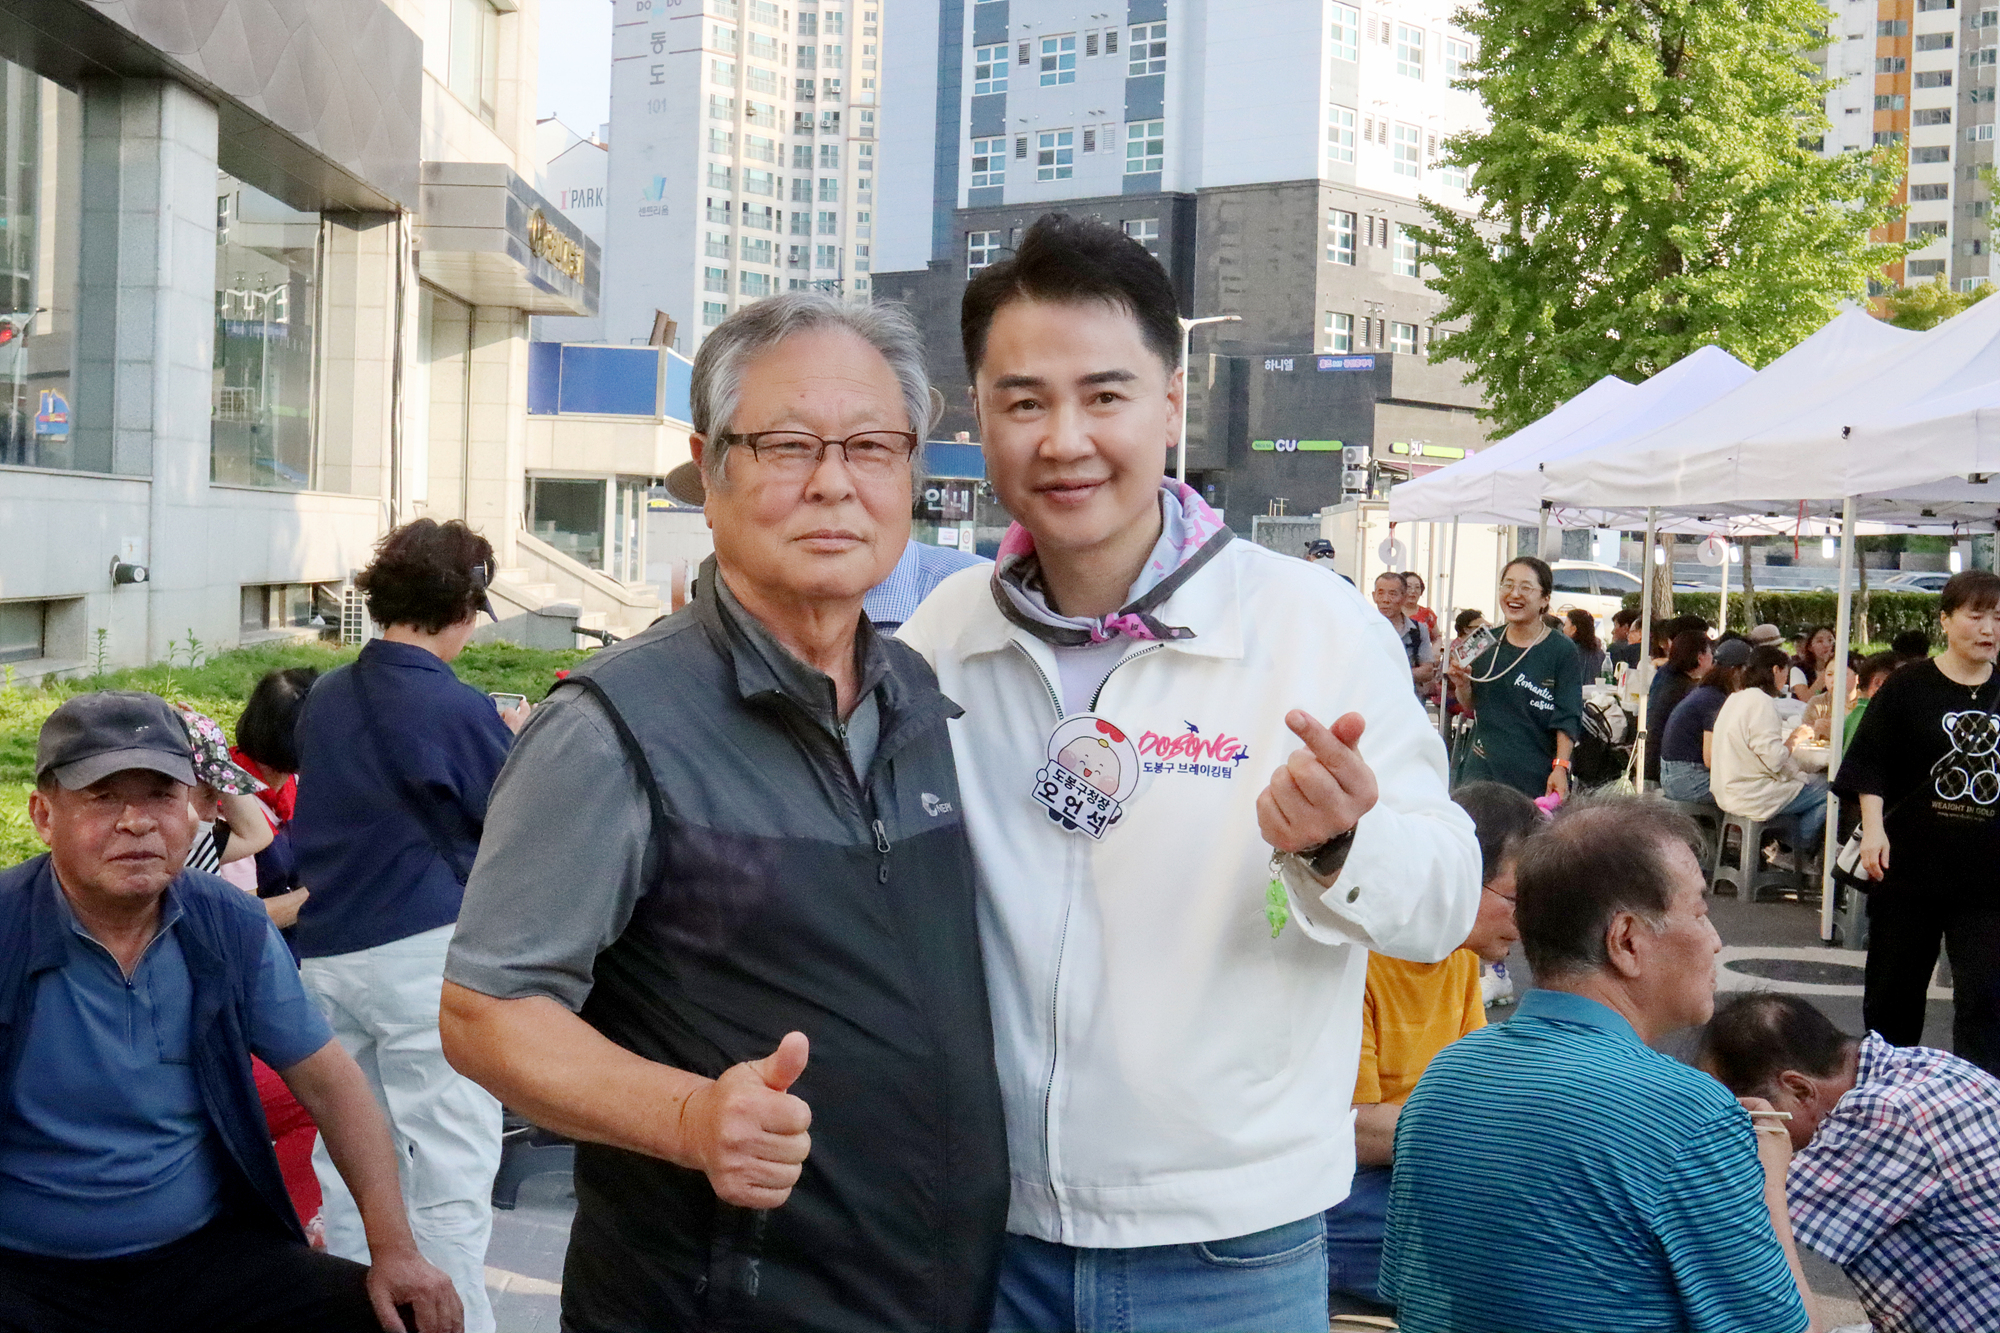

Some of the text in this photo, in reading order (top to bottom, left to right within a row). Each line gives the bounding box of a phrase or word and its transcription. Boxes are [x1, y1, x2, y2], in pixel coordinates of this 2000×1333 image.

[647, 98, 667, 114] 101
[1264, 358, 1294, 371] 하니엘
[1275, 439, 1297, 452] CU
[925, 488, 969, 513] 안내
[1513, 673, 1555, 701] Romantic
[1138, 731, 1241, 762] DOBONG
[1143, 762, 1232, 779] 도봉구 브레이킹팀
[1052, 768, 1111, 811] 도봉구청장
[1976, 807, 1995, 817] GOLD
